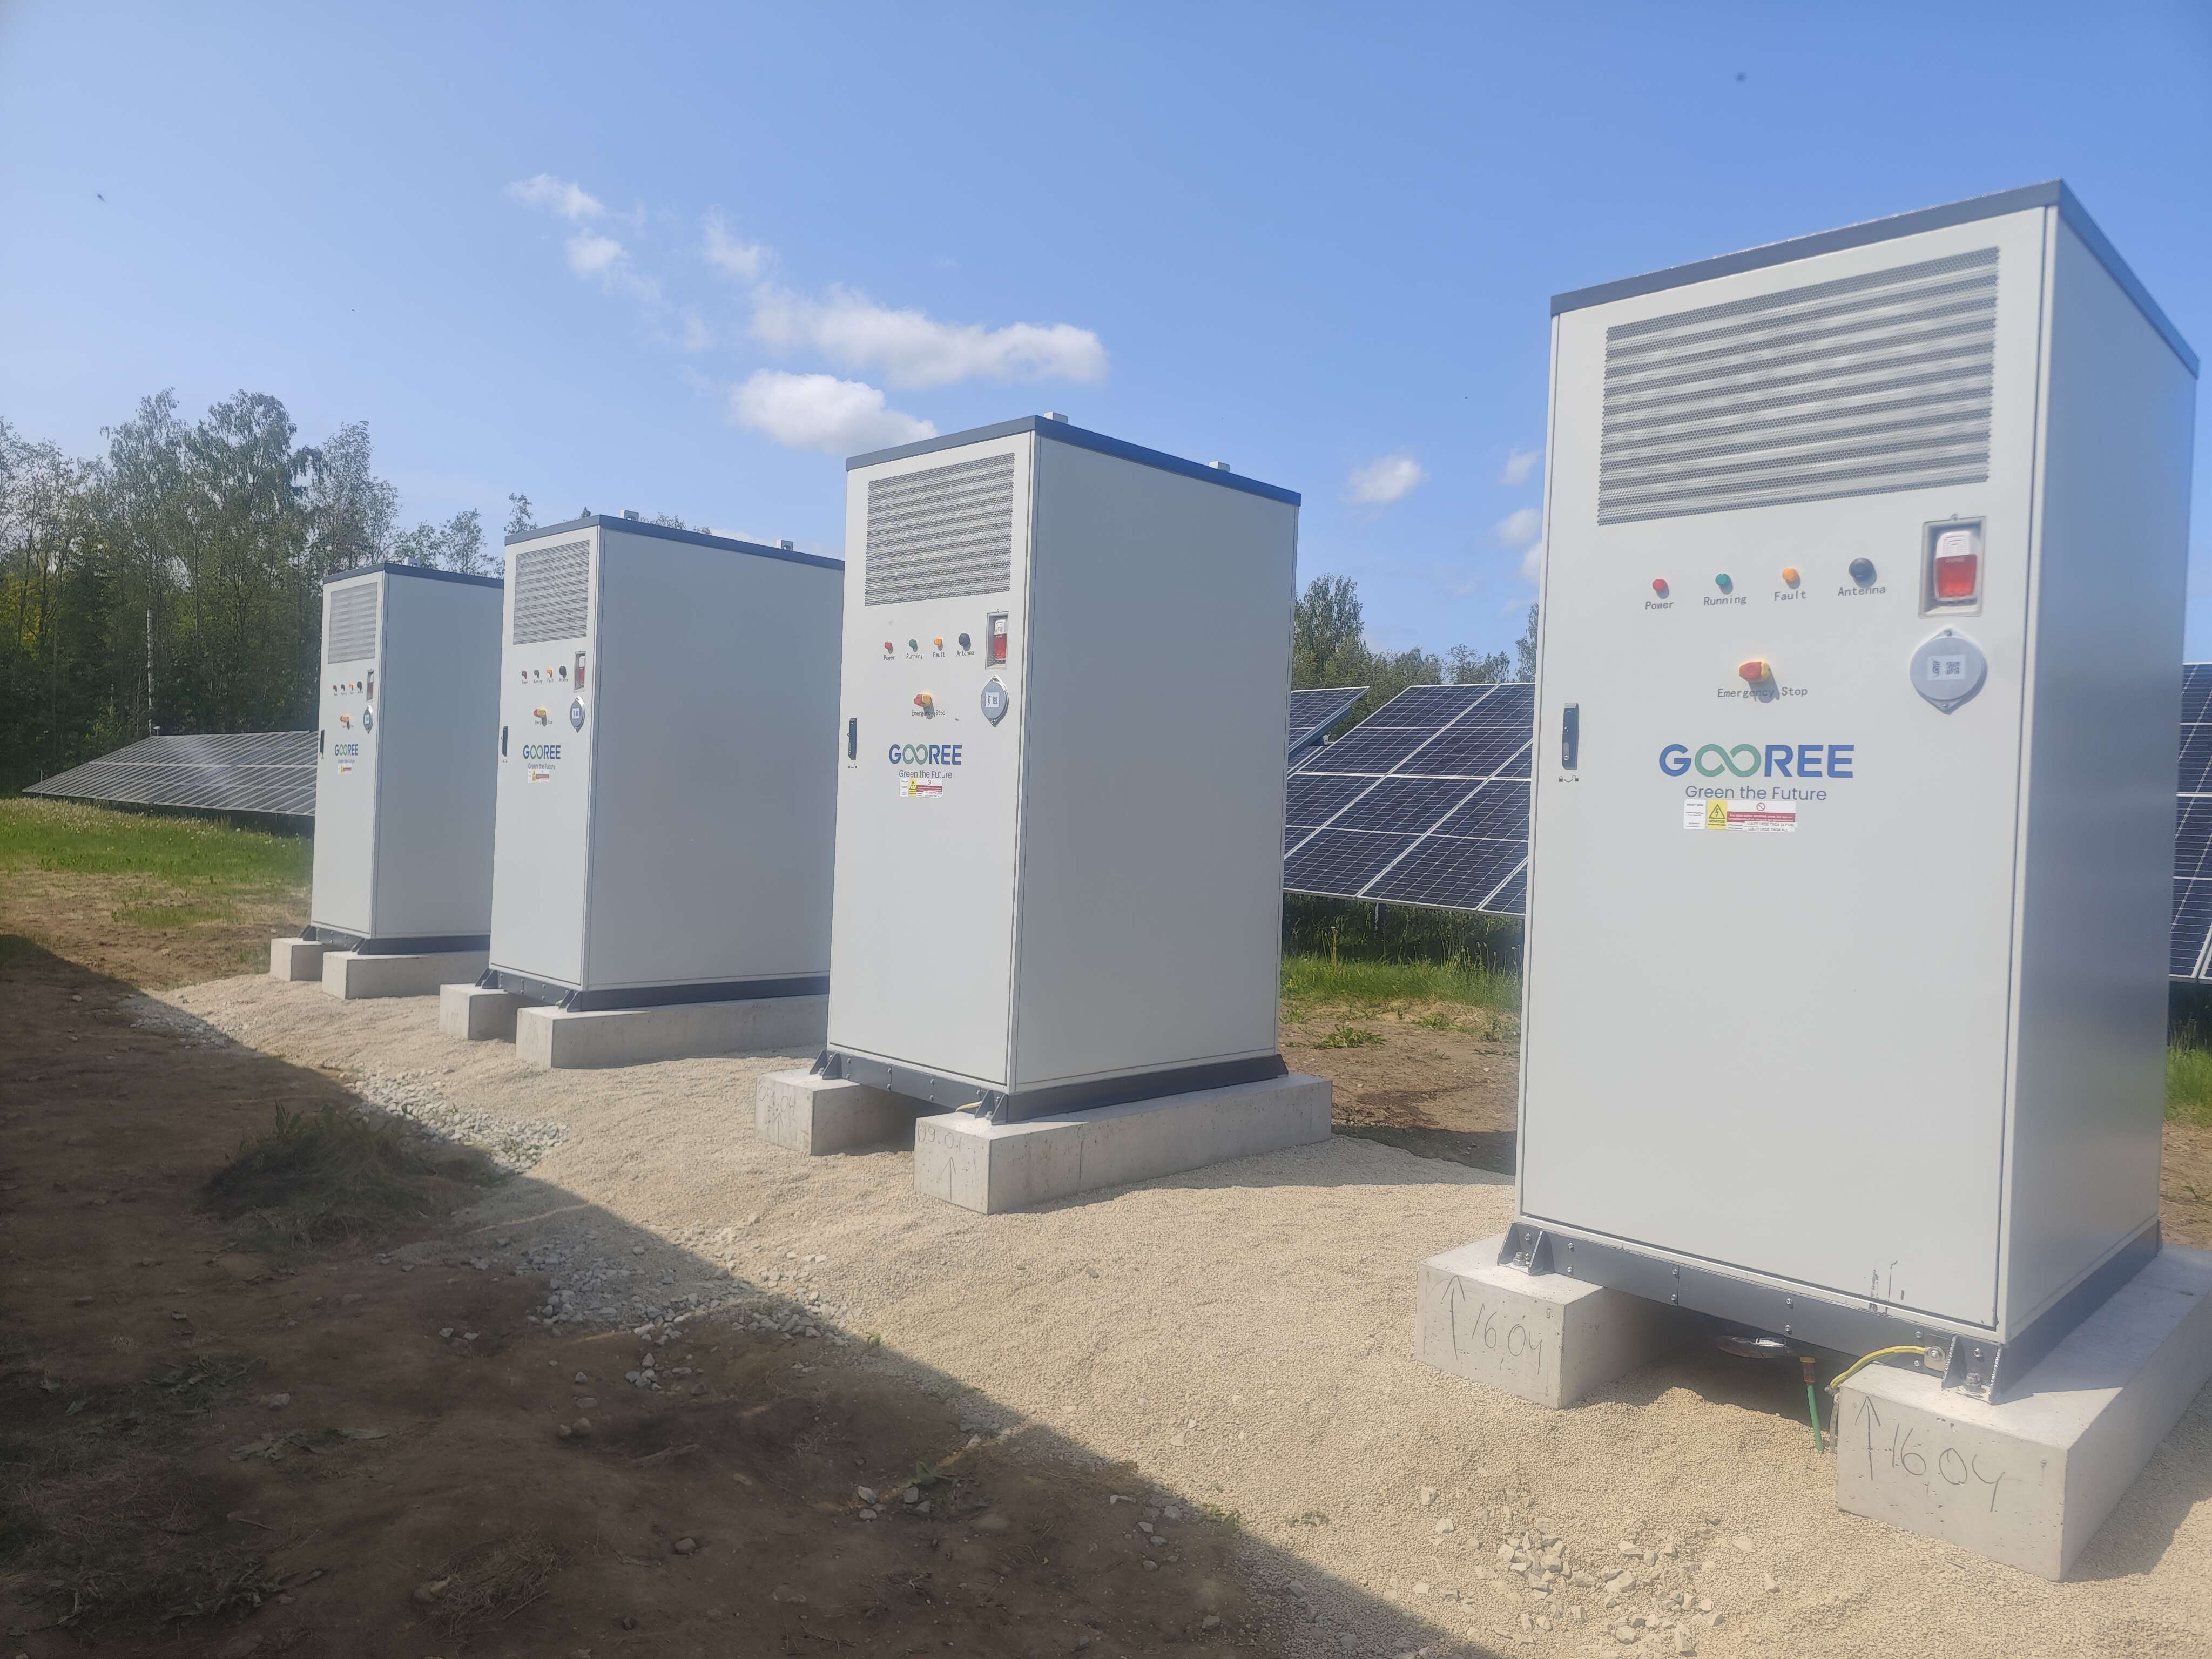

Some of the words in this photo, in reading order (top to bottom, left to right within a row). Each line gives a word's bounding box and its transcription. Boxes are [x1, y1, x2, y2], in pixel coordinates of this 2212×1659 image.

[1774, 590, 1806, 601] Fault
[1837, 586, 1886, 597] Antenna
[1645, 601, 1675, 610] Power
[1703, 595, 1747, 606] Running
[1717, 688, 1775, 698] Emergency
[1781, 686, 1808, 697] Stop
[523, 744, 561, 759] GOOREE
[888, 744, 962, 765] GOOREE
[1659, 744, 1855, 778] GOOREE
[899, 770, 918, 778] Green
[1685, 785, 1735, 798] Green
[1739, 786, 1767, 799] the
[1772, 787, 1827, 800] Future
